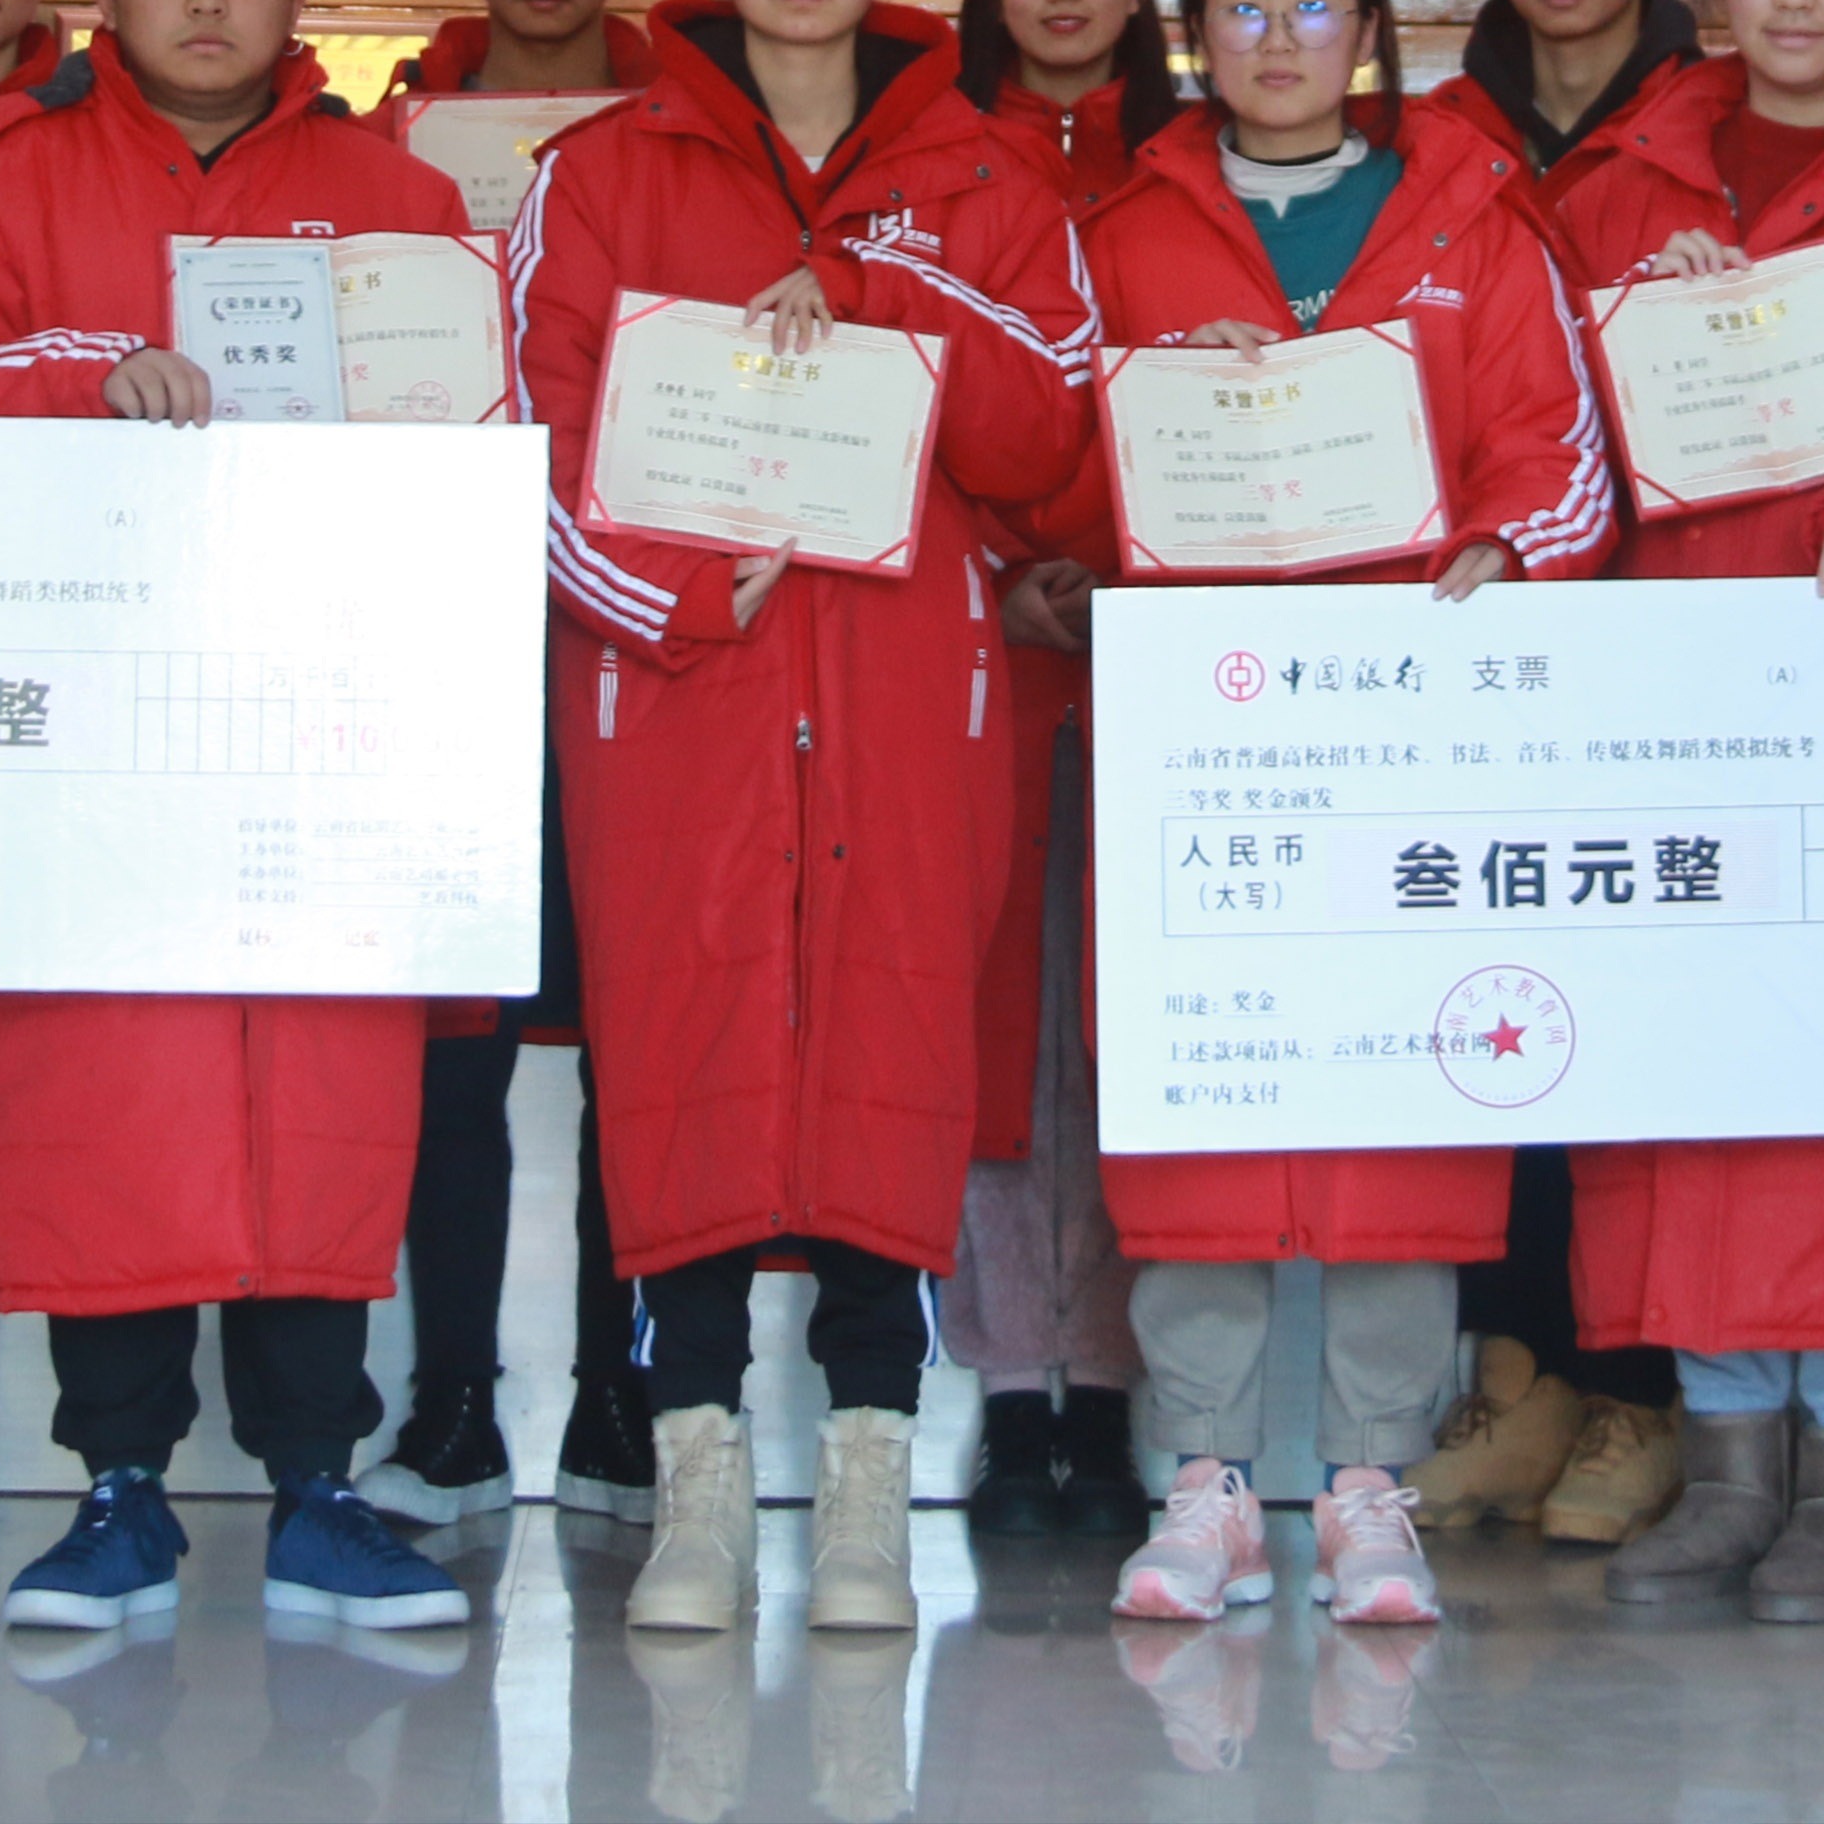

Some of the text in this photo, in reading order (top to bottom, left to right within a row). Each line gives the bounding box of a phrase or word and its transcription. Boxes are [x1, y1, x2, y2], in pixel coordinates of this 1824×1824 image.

[223, 345, 297, 365] 优秀奖
[1213, 381, 1303, 409] 荣誉证书
[1472, 653, 1550, 692] 支票
[1164, 788, 1233, 812] 三等奖
[1179, 832, 1305, 870] 人民币
[1391, 834, 1725, 911] 叁佰元整
[1231, 989, 1277, 1013] 奖金
[1163, 1081, 1280, 1106] 账户内支付
